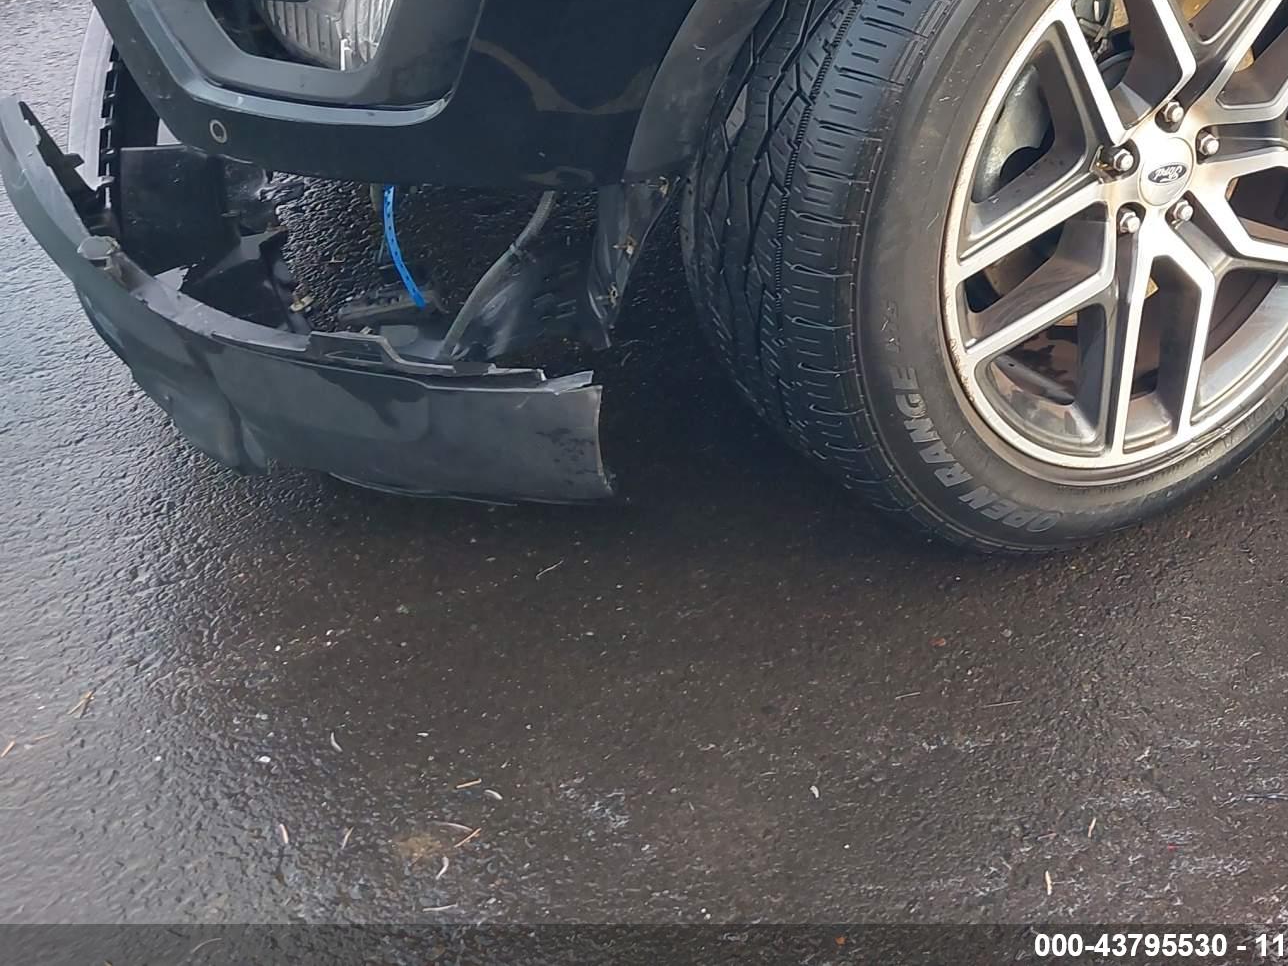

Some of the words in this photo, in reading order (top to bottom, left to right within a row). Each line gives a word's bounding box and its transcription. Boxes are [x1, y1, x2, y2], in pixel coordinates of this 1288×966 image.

[1152, 165, 1184, 183] Ford
[891, 366, 974, 488] RANGE
[958, 485, 1060, 533] OPEN
